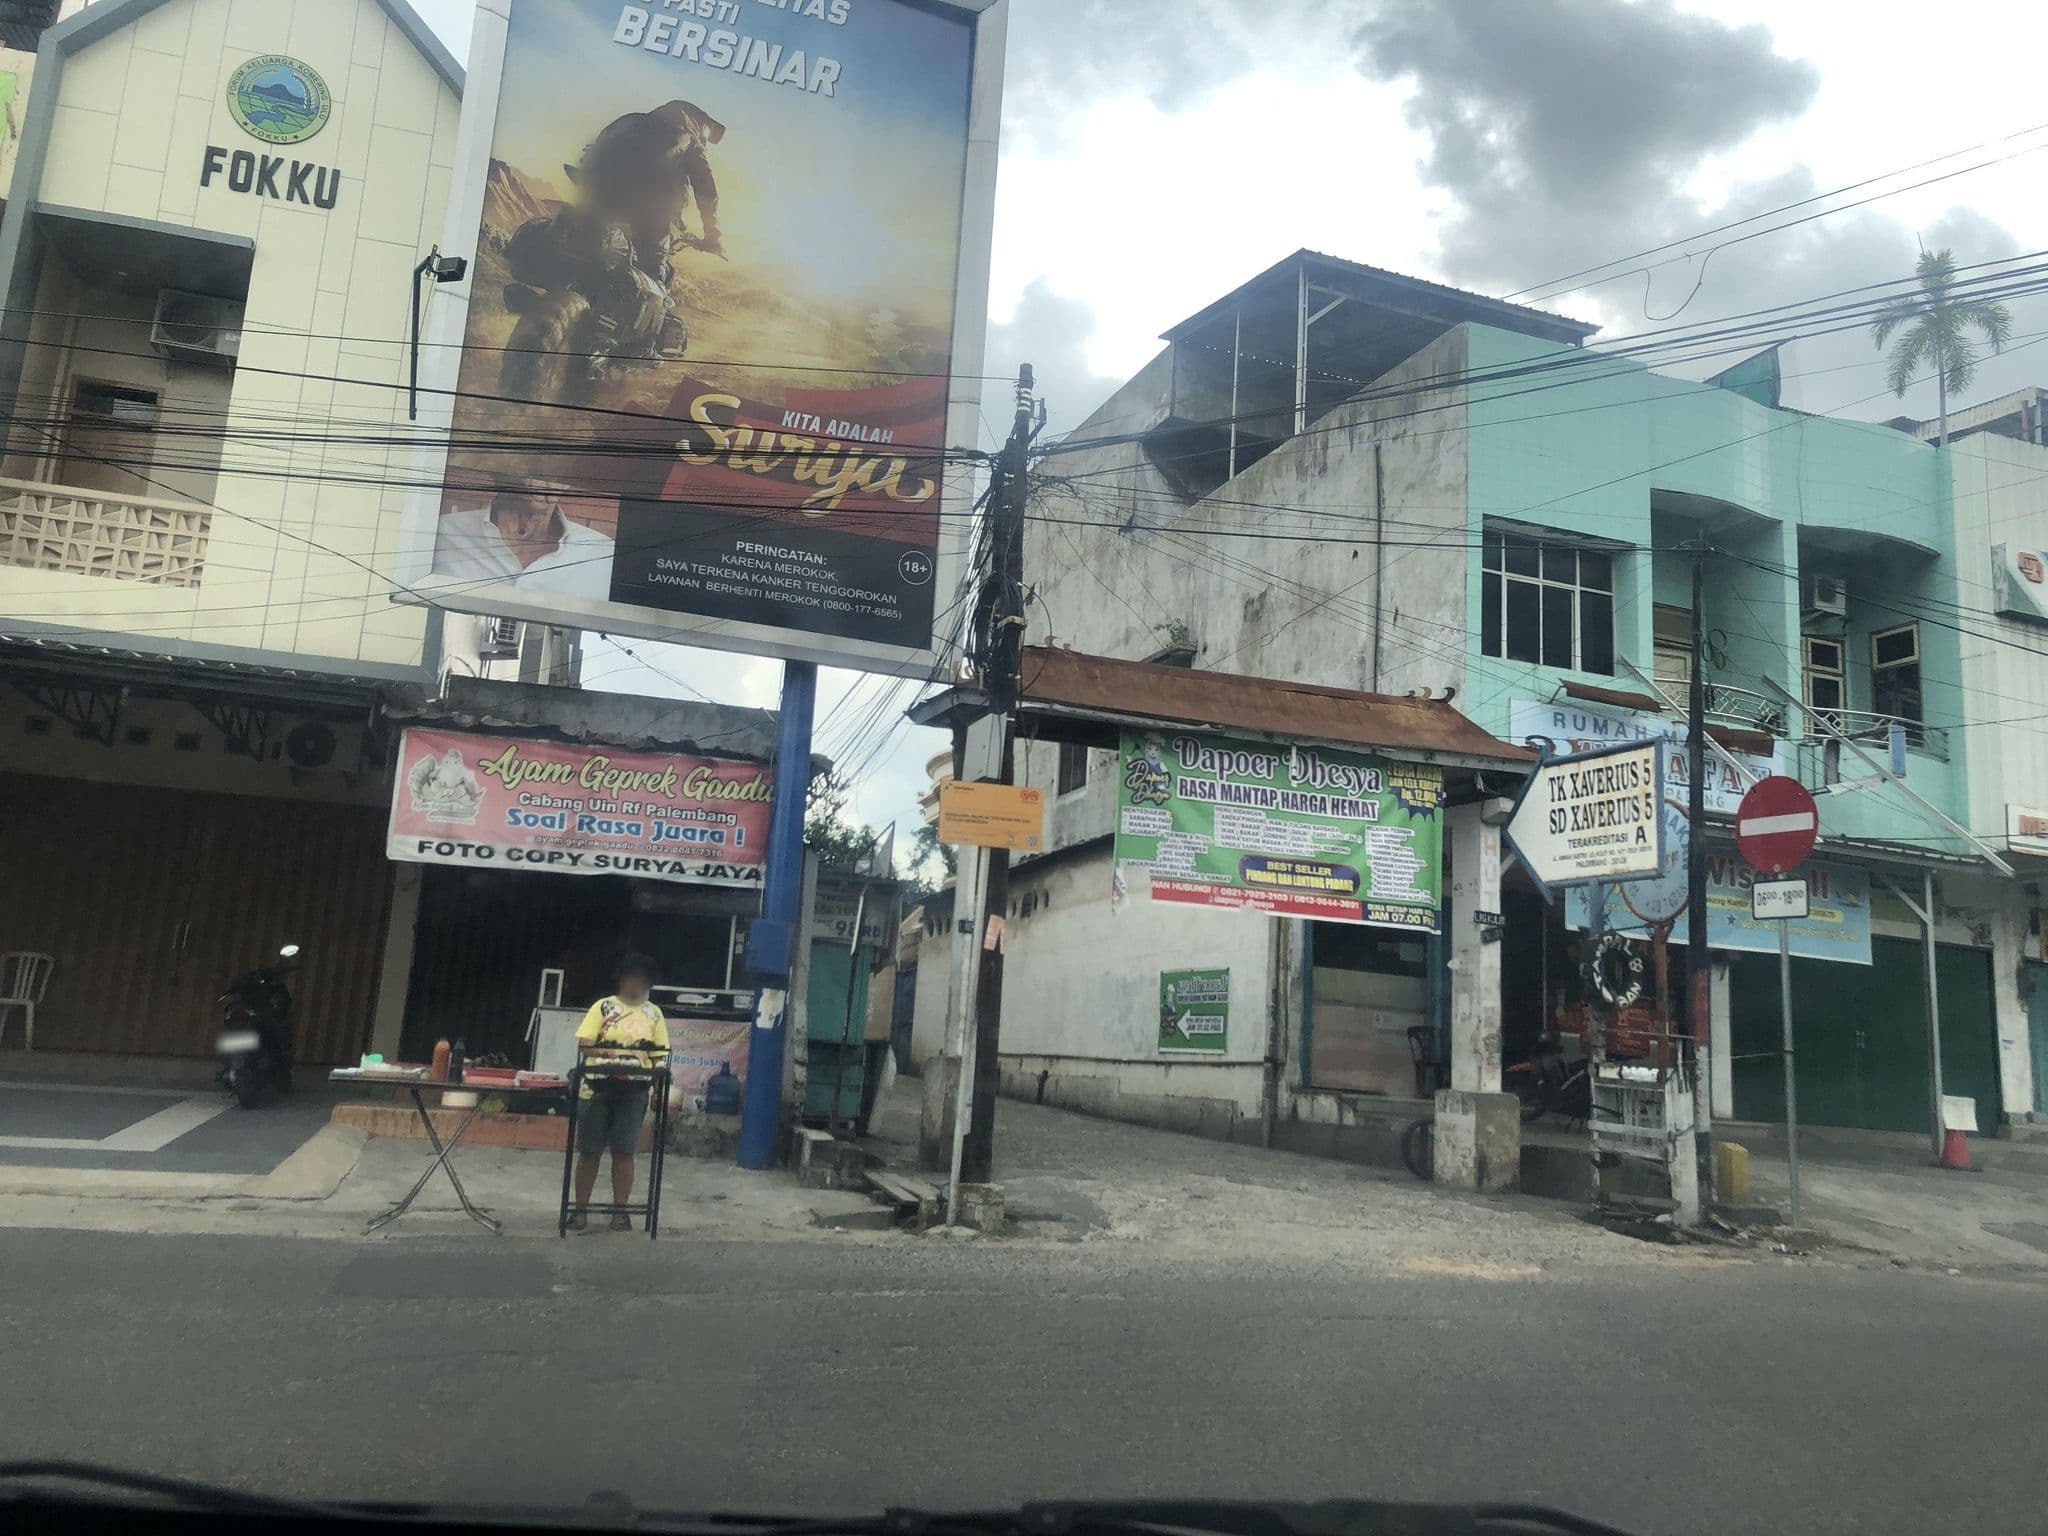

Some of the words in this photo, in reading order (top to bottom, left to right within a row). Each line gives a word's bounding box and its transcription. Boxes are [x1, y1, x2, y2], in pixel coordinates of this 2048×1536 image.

[613, 5, 843, 97] BERSINAR
[246, 56, 294, 71] KELUARGA
[298, 63, 329, 102] KOMERING
[250, 126, 288, 142] FOKKU
[200, 145, 341, 209] FOKKU
[781, 410, 820, 434] KITA
[825, 419, 894, 444] ADALAH
[676, 393, 935, 519] Surya
[721, 553, 771, 571] KARENA
[774, 562, 839, 582] MEROKOK.
[736, 540, 827, 566] PERINGATAN:
[903, 561, 928, 573] 18+
[648, 573, 700, 589] LAYANAN
[706, 581, 762, 598] BERHENTI
[764, 590, 821, 607] MEROKOK
[823, 600, 902, 621] (0800-177-6565)
[656, 558, 689, 572] SAYA
[691, 563, 749, 582] TERKENA
[751, 573, 801, 590] KANKER
[804, 581, 897, 604] TENGGOROKAN
[1553, 711, 1648, 742] RUMAH
[478, 744, 576, 790] Ayam
[578, 755, 678, 799] Geprek
[682, 765, 774, 804] Gaadu
[1173, 736, 1278, 780] Dapoer
[1281, 749, 1382, 797] Dhesya
[1548, 776, 1566, 802] TK
[1570, 761, 1639, 799] XAVERIUS
[1643, 759, 1651, 786] 5
[519, 792, 584, 812] Cabang
[588, 798, 617, 813] Uin
[622, 802, 641, 815] Rf
[646, 804, 738, 826] Palembang
[1179, 778, 1216, 800] RASA
[1220, 783, 1277, 807] MANTAP
[1281, 790, 1327, 814] HARGA
[1331, 796, 1377, 819] HEMAT
[1549, 808, 1567, 835] SD
[1571, 795, 1640, 832] XAVERIUS
[1645, 793, 1653, 820] 5
[506, 807, 568, 831] Soal
[577, 811, 643, 838] Rasa
[651, 819, 727, 843] Juara
[735, 826, 745, 847] !
[1568, 833, 1628, 849] TERAKREDITASI
[1635, 826, 1647, 844] A
[418, 840, 495, 859] FOTO
[506, 847, 584, 867] COPY
[594, 854, 686, 874] SURYA
[695, 863, 763, 882] JAYA
[1267, 861, 1292, 872] BEST
[1295, 864, 1332, 876] SELLER
[1368, 910, 1389, 921] JAM
[1391, 913, 1421, 924] 07.00
